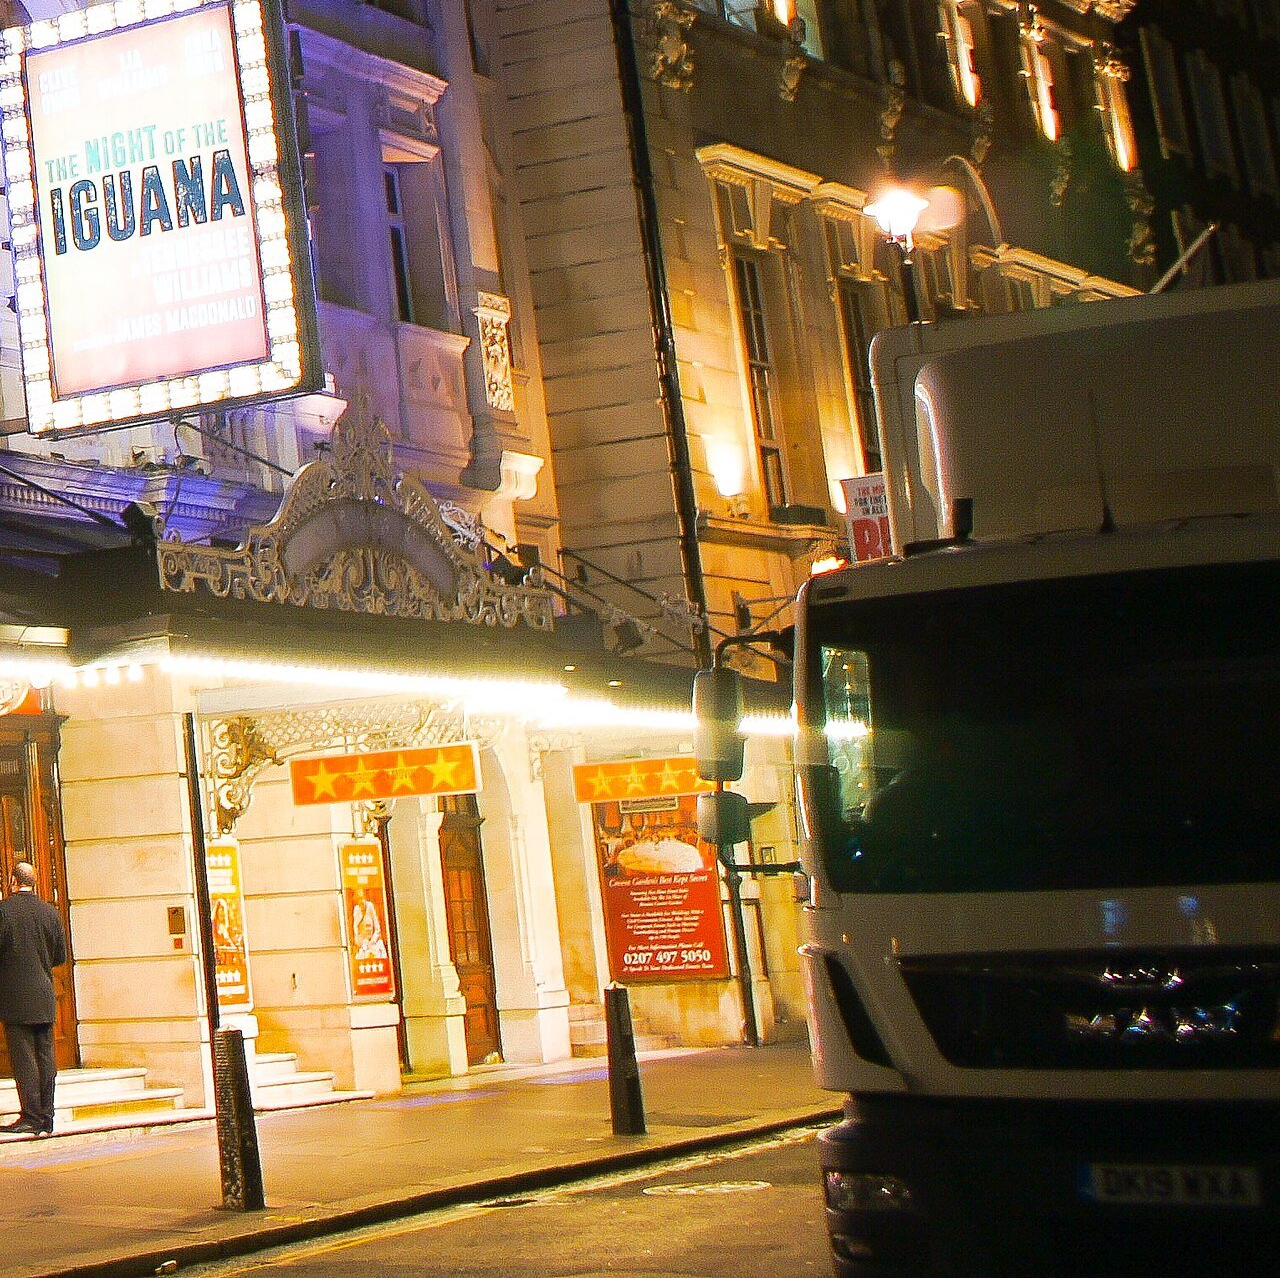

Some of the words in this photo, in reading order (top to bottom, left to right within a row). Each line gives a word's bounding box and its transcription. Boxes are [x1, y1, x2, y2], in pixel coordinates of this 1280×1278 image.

[45, 154, 79, 183] THE
[85, 124, 156, 174] NIGHT
[164, 128, 186, 155] OF
[192, 119, 228, 149] THE
[50, 148, 246, 255] IGUANA
[152, 257, 253, 305] WILLIAMS
[166, 294, 256, 334] MACDONALD
[623, 952, 653, 965] 0207
[656, 951, 678, 964] 497
[681, 949, 711, 963] 5050
